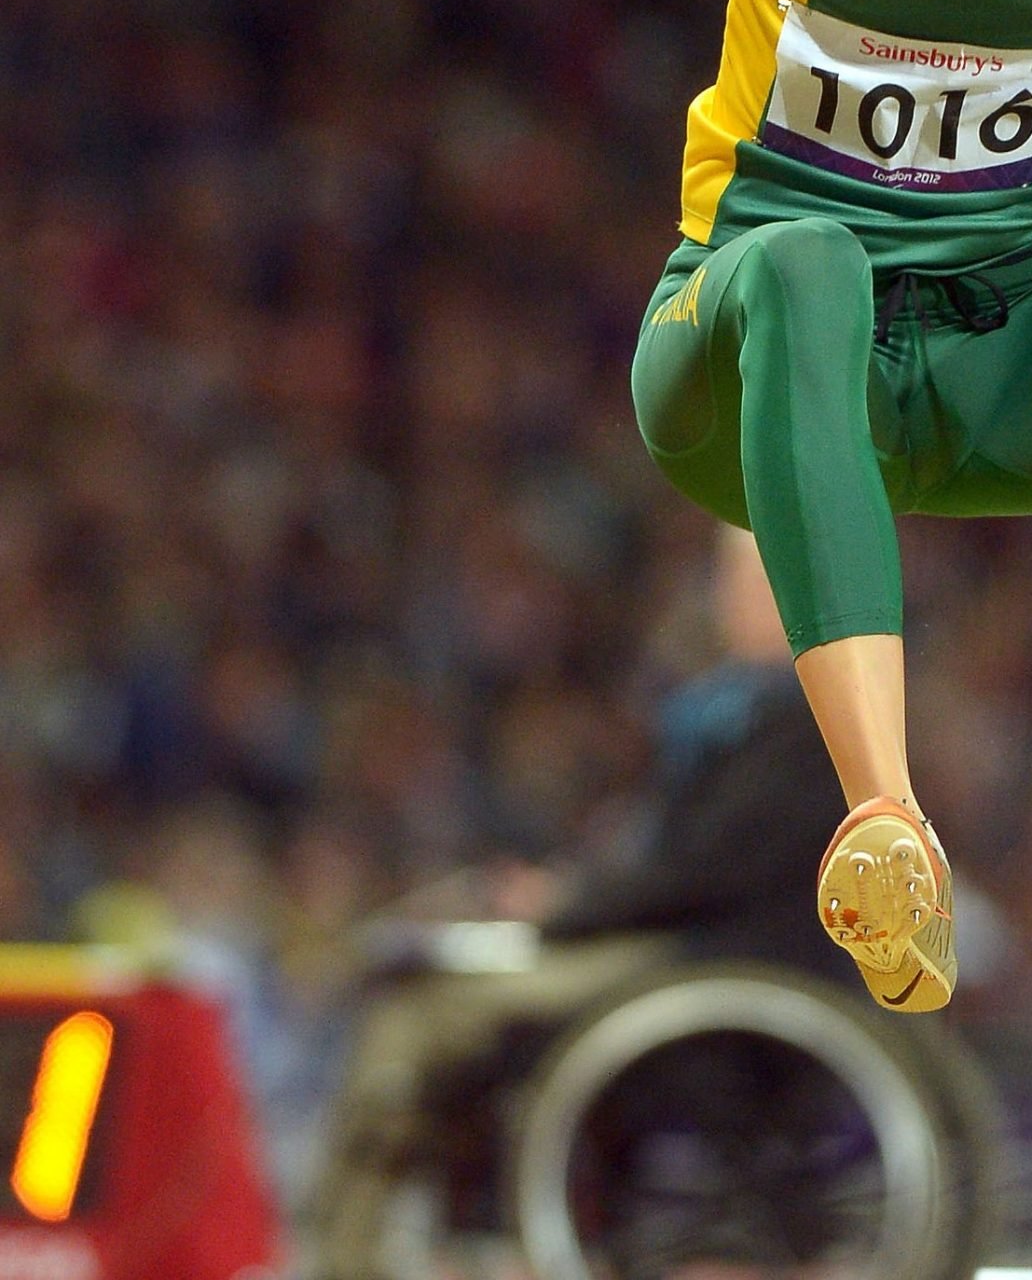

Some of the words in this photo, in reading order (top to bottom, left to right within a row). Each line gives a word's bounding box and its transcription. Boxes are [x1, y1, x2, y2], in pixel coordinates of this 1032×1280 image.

[859, 36, 1004, 76] Sainsbury's
[872, 169, 912, 182] London
[914, 172, 941, 185] 2012
